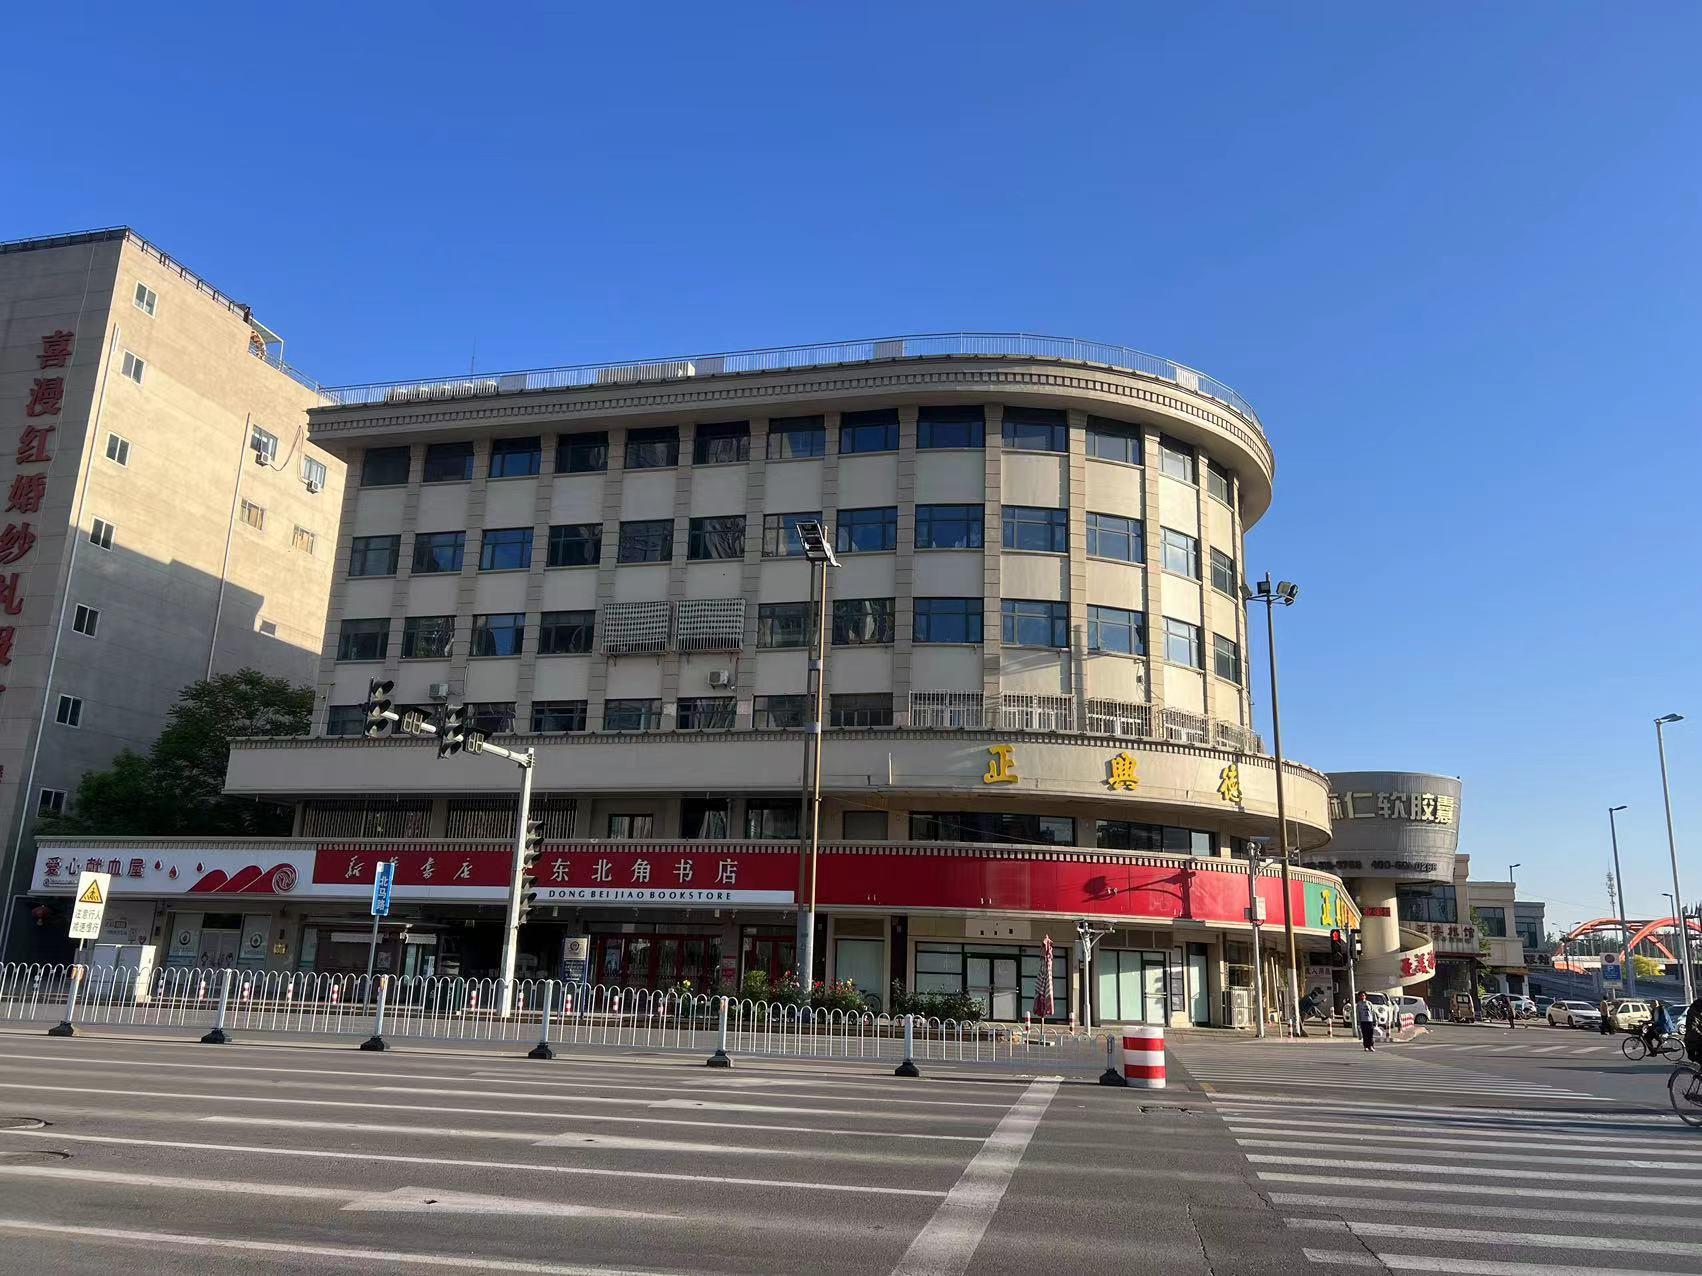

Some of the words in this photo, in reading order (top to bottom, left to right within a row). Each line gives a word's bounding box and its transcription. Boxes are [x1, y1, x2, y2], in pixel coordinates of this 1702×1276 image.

[44, 856, 146, 878] 爱心献血屋
[550, 857, 739, 884] 东北角书店
[376, 876, 389, 911] 北马路
[549, 889, 585, 898] DONG
[591, 890, 610, 898] BEI
[615, 891, 644, 899] JIAO
[650, 891, 731, 900] BOOKSTORE
